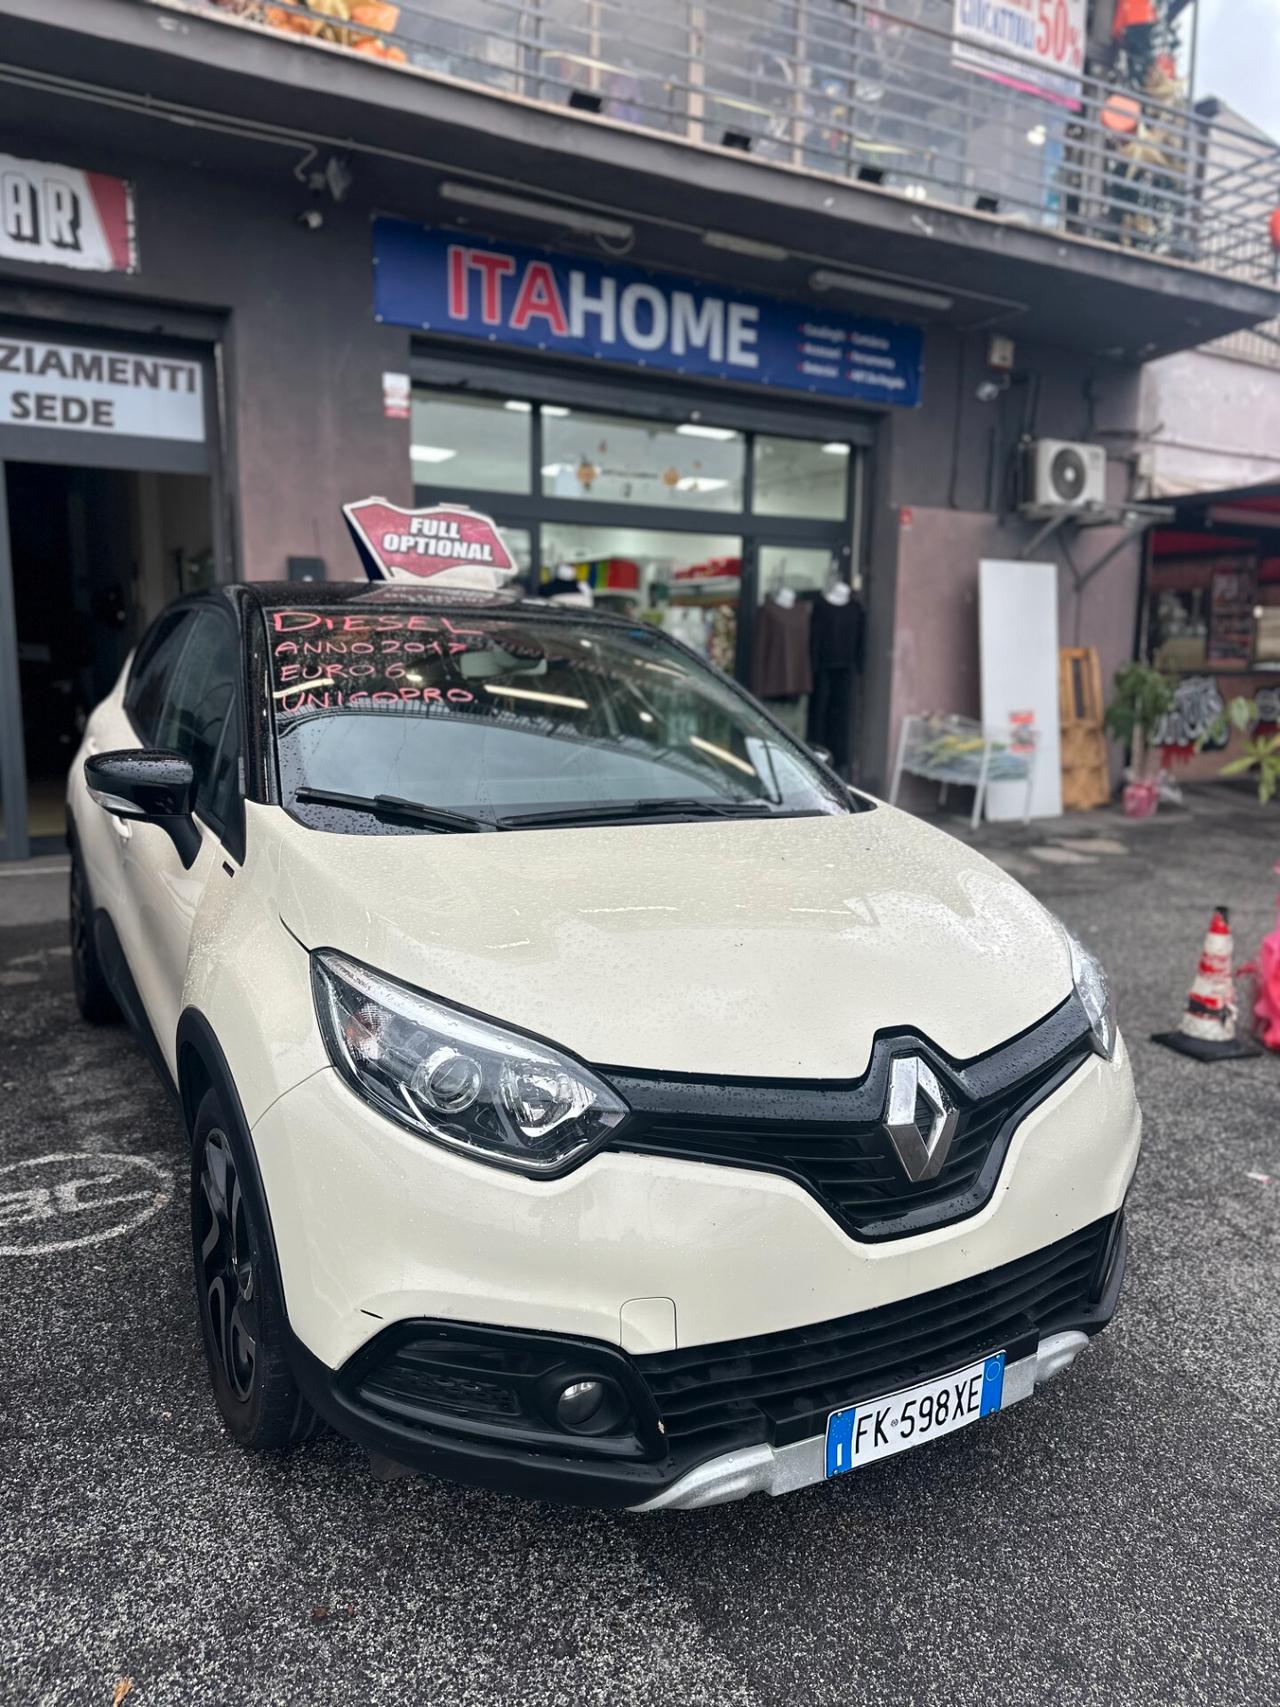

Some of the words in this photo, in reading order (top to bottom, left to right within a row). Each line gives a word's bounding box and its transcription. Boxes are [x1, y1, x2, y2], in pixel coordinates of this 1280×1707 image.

[1, 170, 83, 254] AR
[448, 245, 760, 368] ITAHOME
[0, 345, 196, 392] ZIAMENTI
[11, 391, 114, 427] SEDE
[409, 517, 461, 539] FULL
[382, 533, 494, 562] OPTIONAL
[273, 611, 484, 635] DIESEL
[280, 664, 375, 682] EURO
[384, 663, 406, 679] 6
[855, 1406, 891, 1454] FK
